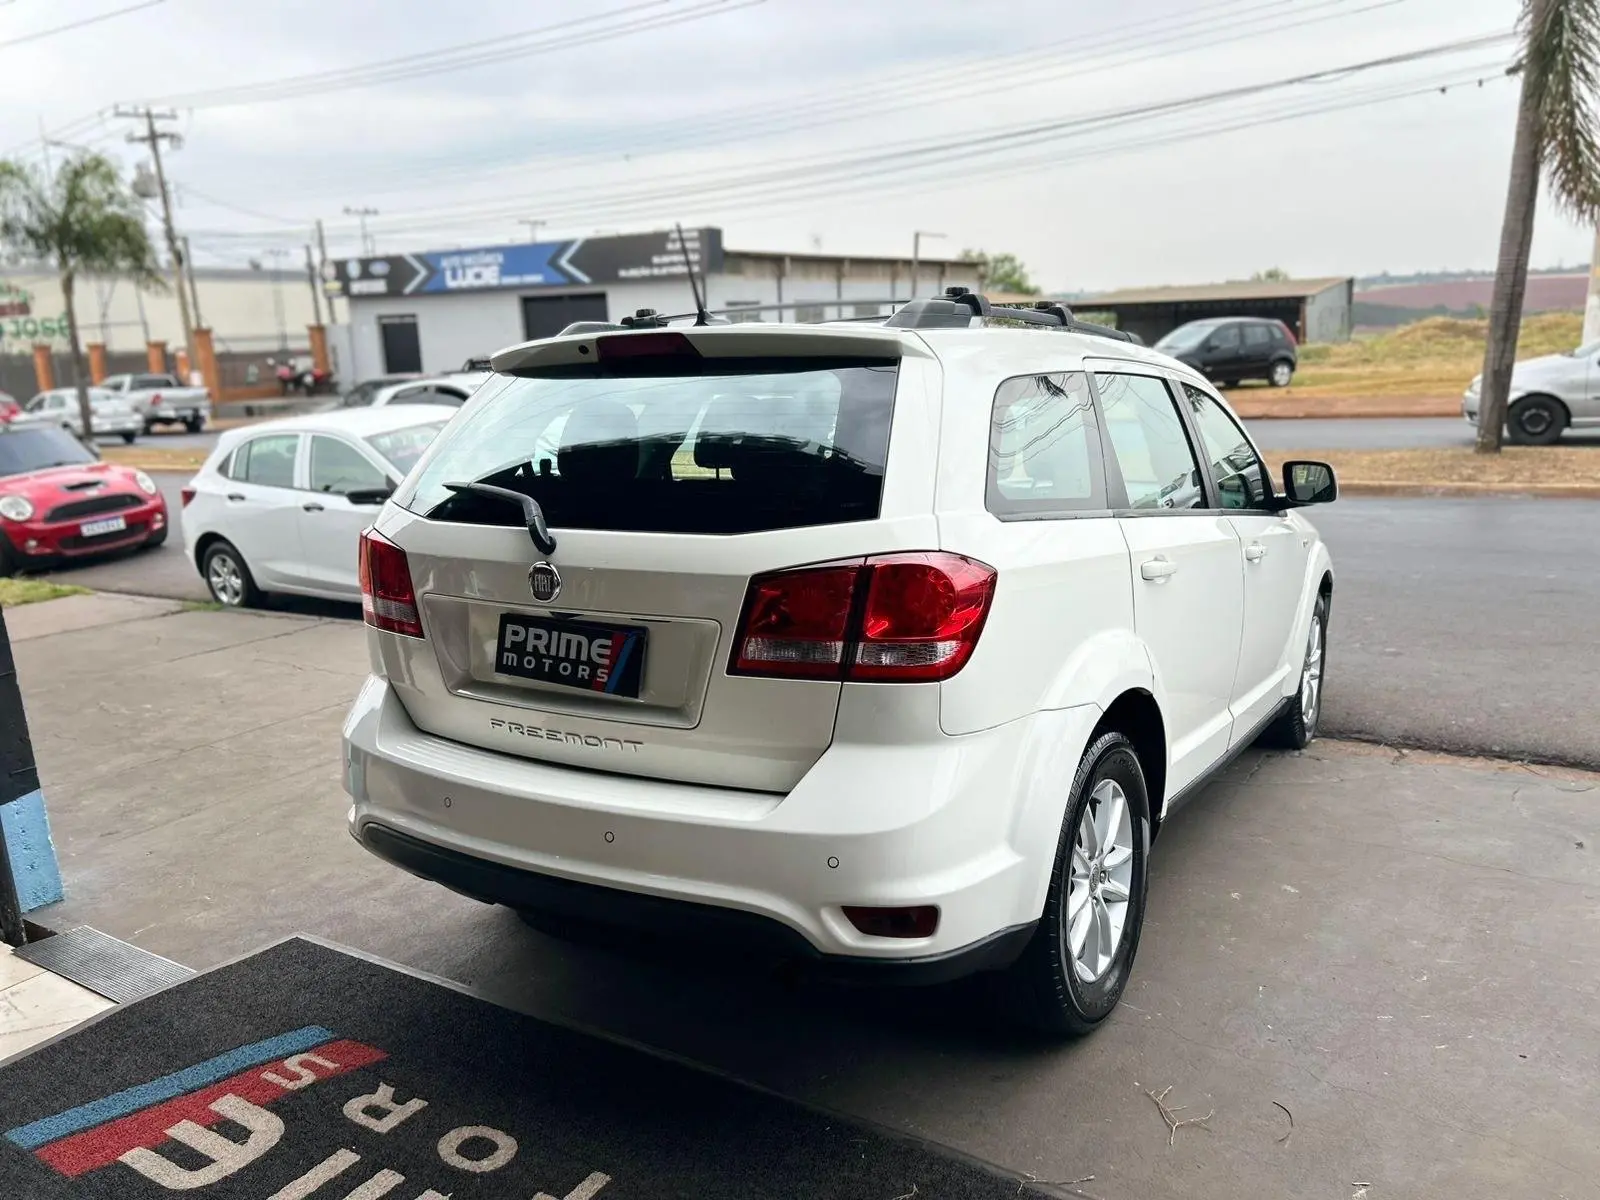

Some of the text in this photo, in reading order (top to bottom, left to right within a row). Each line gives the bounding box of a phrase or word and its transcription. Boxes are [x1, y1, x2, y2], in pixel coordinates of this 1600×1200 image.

[533, 573, 552, 593] FIAT
[504, 623, 613, 666] PRIME
[502, 652, 609, 683] MOTORS
[489, 717, 645, 753] FREEMONT
